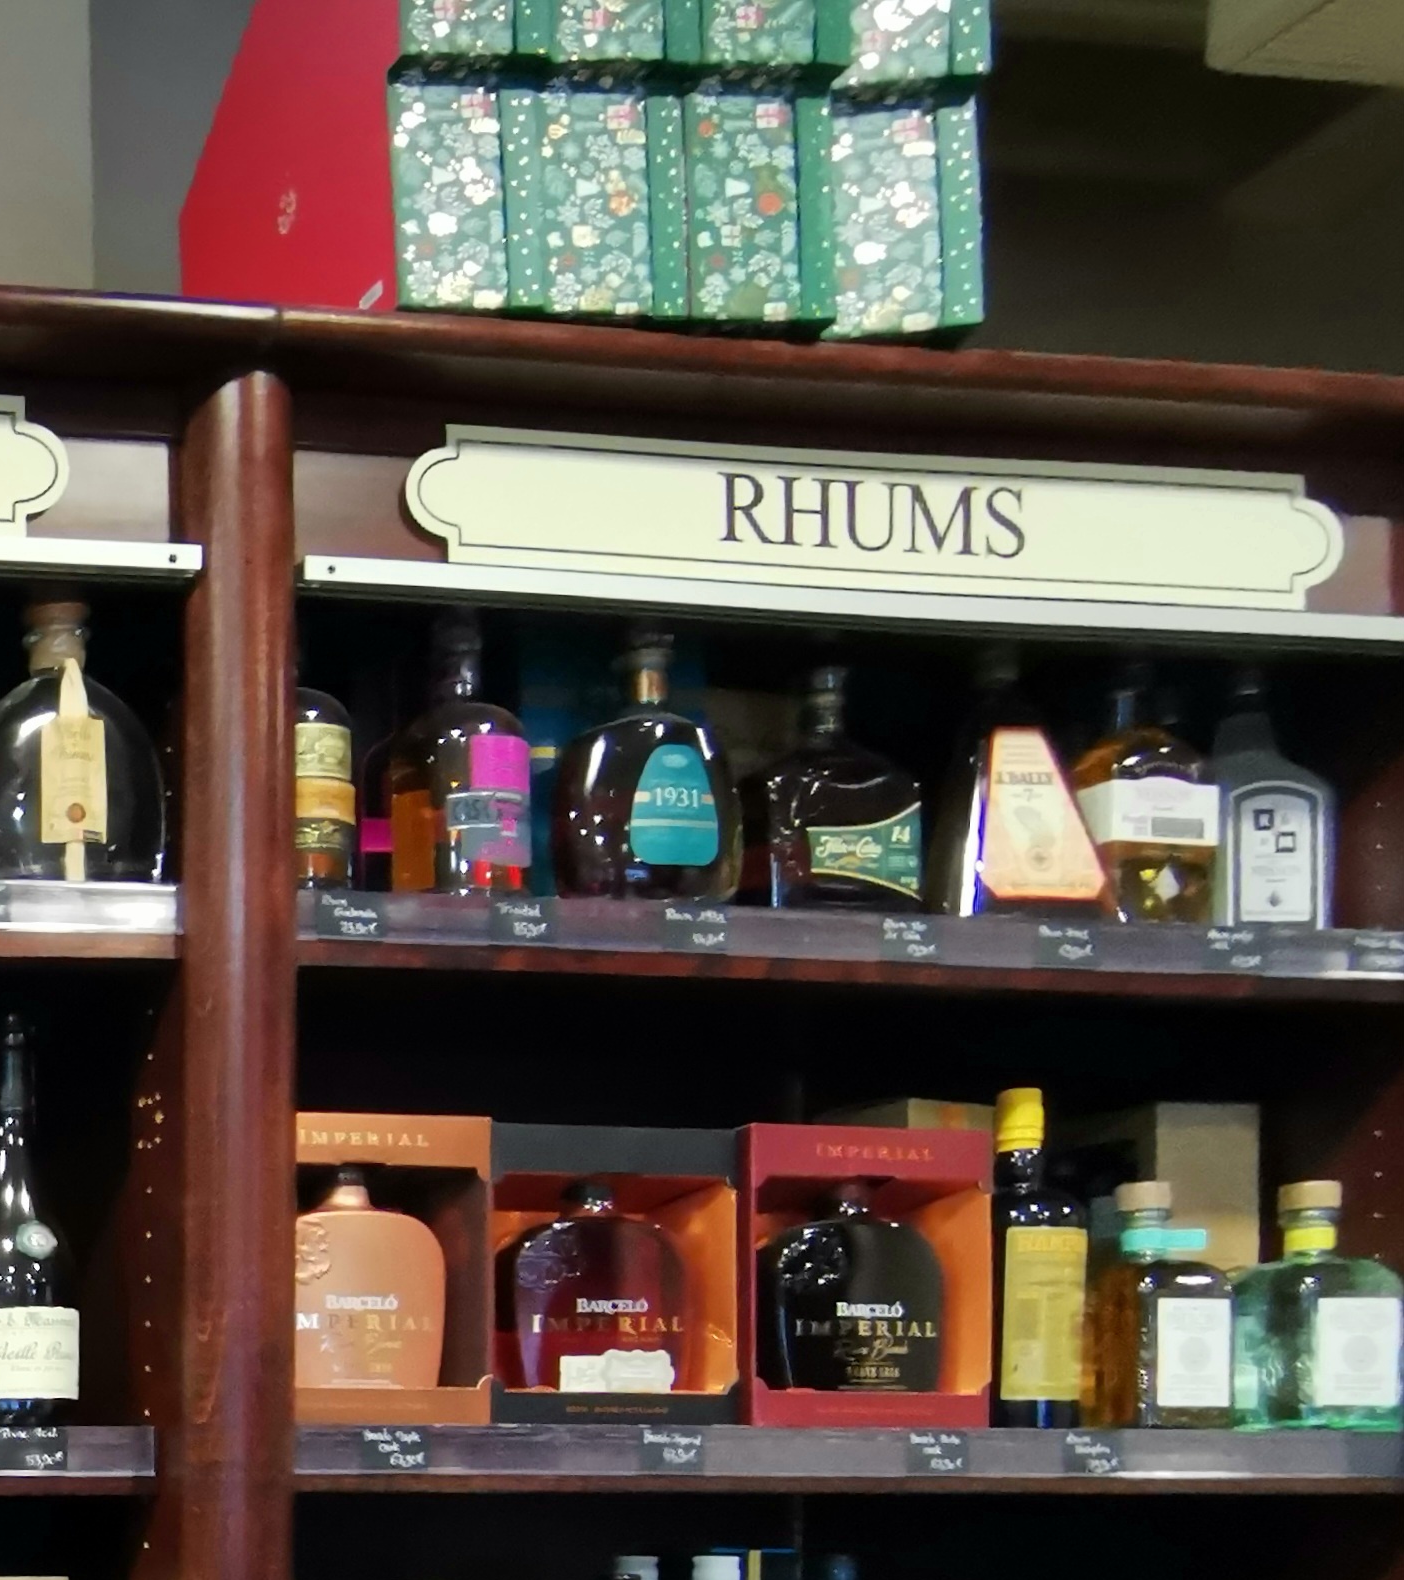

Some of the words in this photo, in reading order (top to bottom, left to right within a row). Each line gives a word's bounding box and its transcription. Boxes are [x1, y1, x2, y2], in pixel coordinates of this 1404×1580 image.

[716, 470, 1027, 560] RHUMS
[653, 786, 699, 809] 1931
[298, 1128, 430, 1148] IMPERIAL
[816, 1143, 935, 1161] IMPERIAL
[531, 1313, 685, 1334] IMPERIAL
[795, 1319, 938, 1338] IMPERIAL
